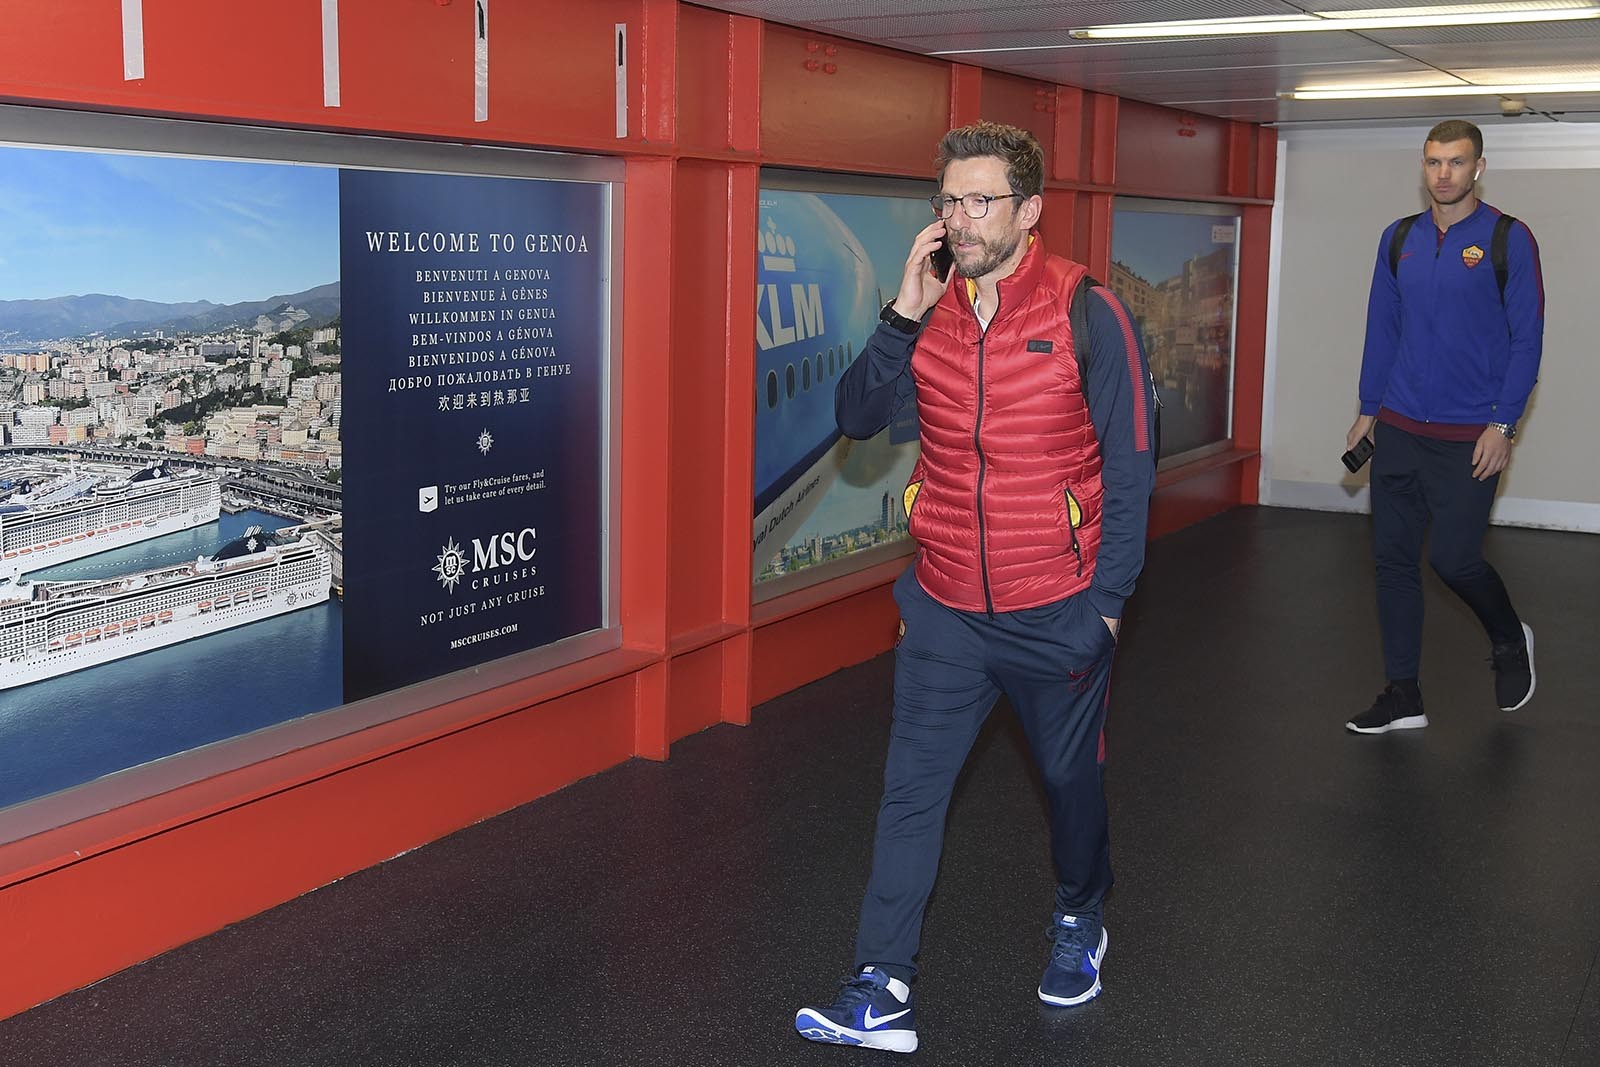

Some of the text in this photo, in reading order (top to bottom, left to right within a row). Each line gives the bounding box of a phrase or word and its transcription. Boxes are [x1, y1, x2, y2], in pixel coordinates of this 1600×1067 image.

[366, 232, 587, 252] WELCOME TO GENOA
[416, 270, 550, 281] BENVENUTI A GENOVA
[424, 287, 547, 303] BIENVENUE À GÊNES
[409, 308, 555, 324] WILLKOMMEN IN GENUA
[413, 327, 552, 345] BEM-VINDOS A GÉNOVA
[409, 346, 555, 367] BIENVENIDOS A GÉNOVA
[389, 364, 570, 392] ДОБРО ПОЖАЛОВАТЬ В ГЕНУЕ
[439, 388, 529, 411] 欢迎来到热那亚
[444, 468, 545, 494] Try our Fly&Cruise fares, and
[444, 480, 546, 505] let us take care of every detail.
[753, 524, 768, 552] yal
[769, 501, 794, 533] Dutch
[472, 527, 536, 572] MSC
[472, 566, 537, 590] CRUISES
[421, 586, 544, 625] NOT JUST ANY CRUISE
[451, 624, 517, 649] MSCCRUISES.COM
